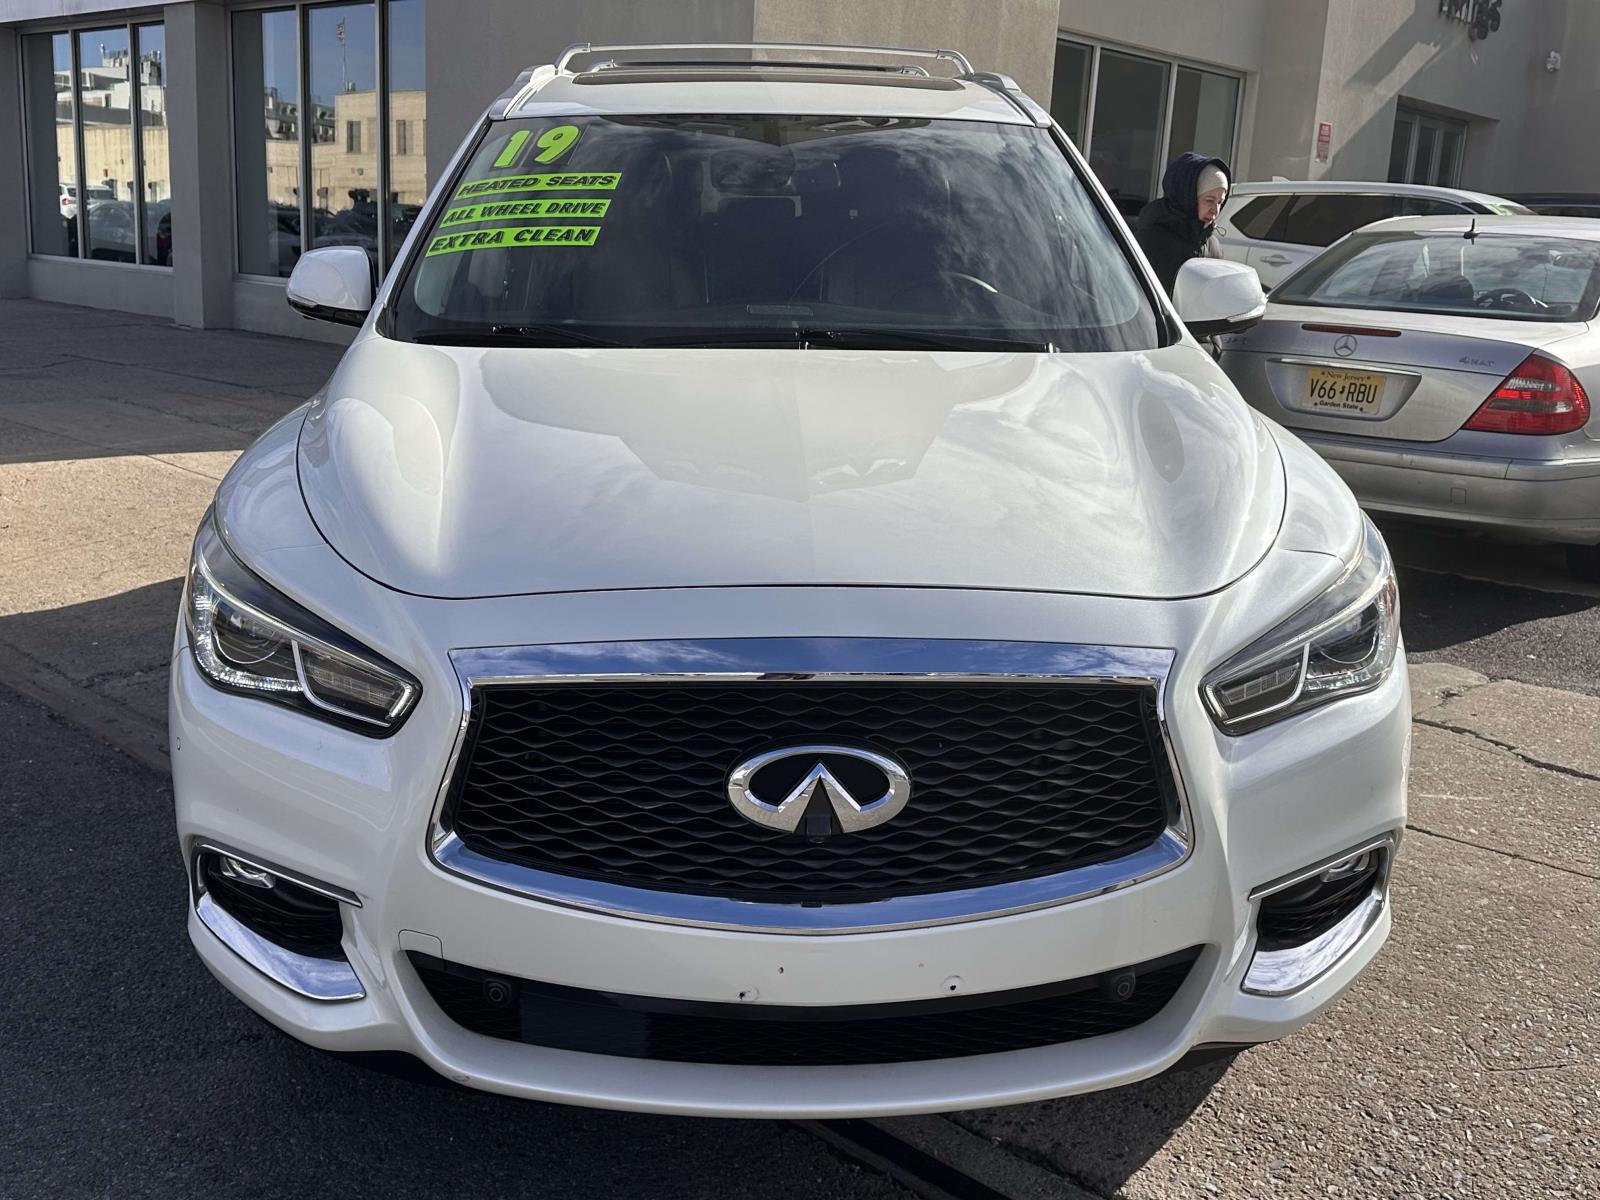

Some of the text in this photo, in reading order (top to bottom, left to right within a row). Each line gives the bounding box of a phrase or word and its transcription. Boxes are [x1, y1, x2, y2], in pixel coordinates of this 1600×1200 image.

[494, 125, 581, 168] 19
[458, 175, 616, 196] HEATED SEATS
[443, 201, 606, 225] ALL WHEEL DRIVE
[429, 228, 595, 252] EXTRA CLEAN
[1327, 371, 1365, 382] New Jersey
[1310, 378, 1378, 404] V66 RBU
[1319, 400, 1359, 410] Garden State
